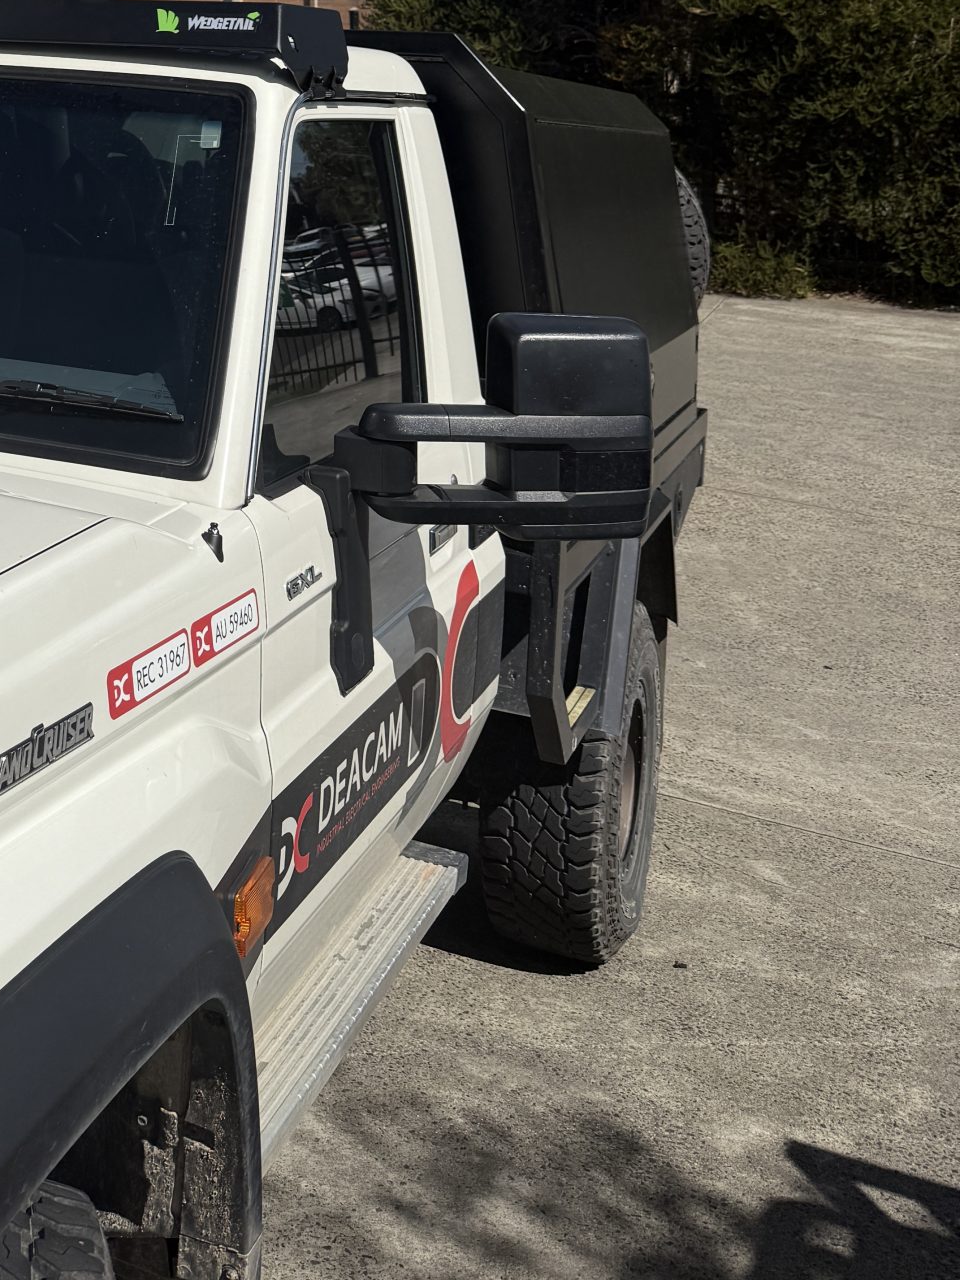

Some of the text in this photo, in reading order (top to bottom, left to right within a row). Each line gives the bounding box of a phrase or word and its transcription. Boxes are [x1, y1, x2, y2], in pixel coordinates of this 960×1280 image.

[187, 13, 255, 31] WEDGETAIL
[286, 565, 323, 601] GXL
[215, 618, 228, 643] AU
[229, 603, 254, 634] 59460
[136, 661, 155, 691] REC
[157, 642, 186, 678] 31967
[318, 702, 403, 834] DEACAM
